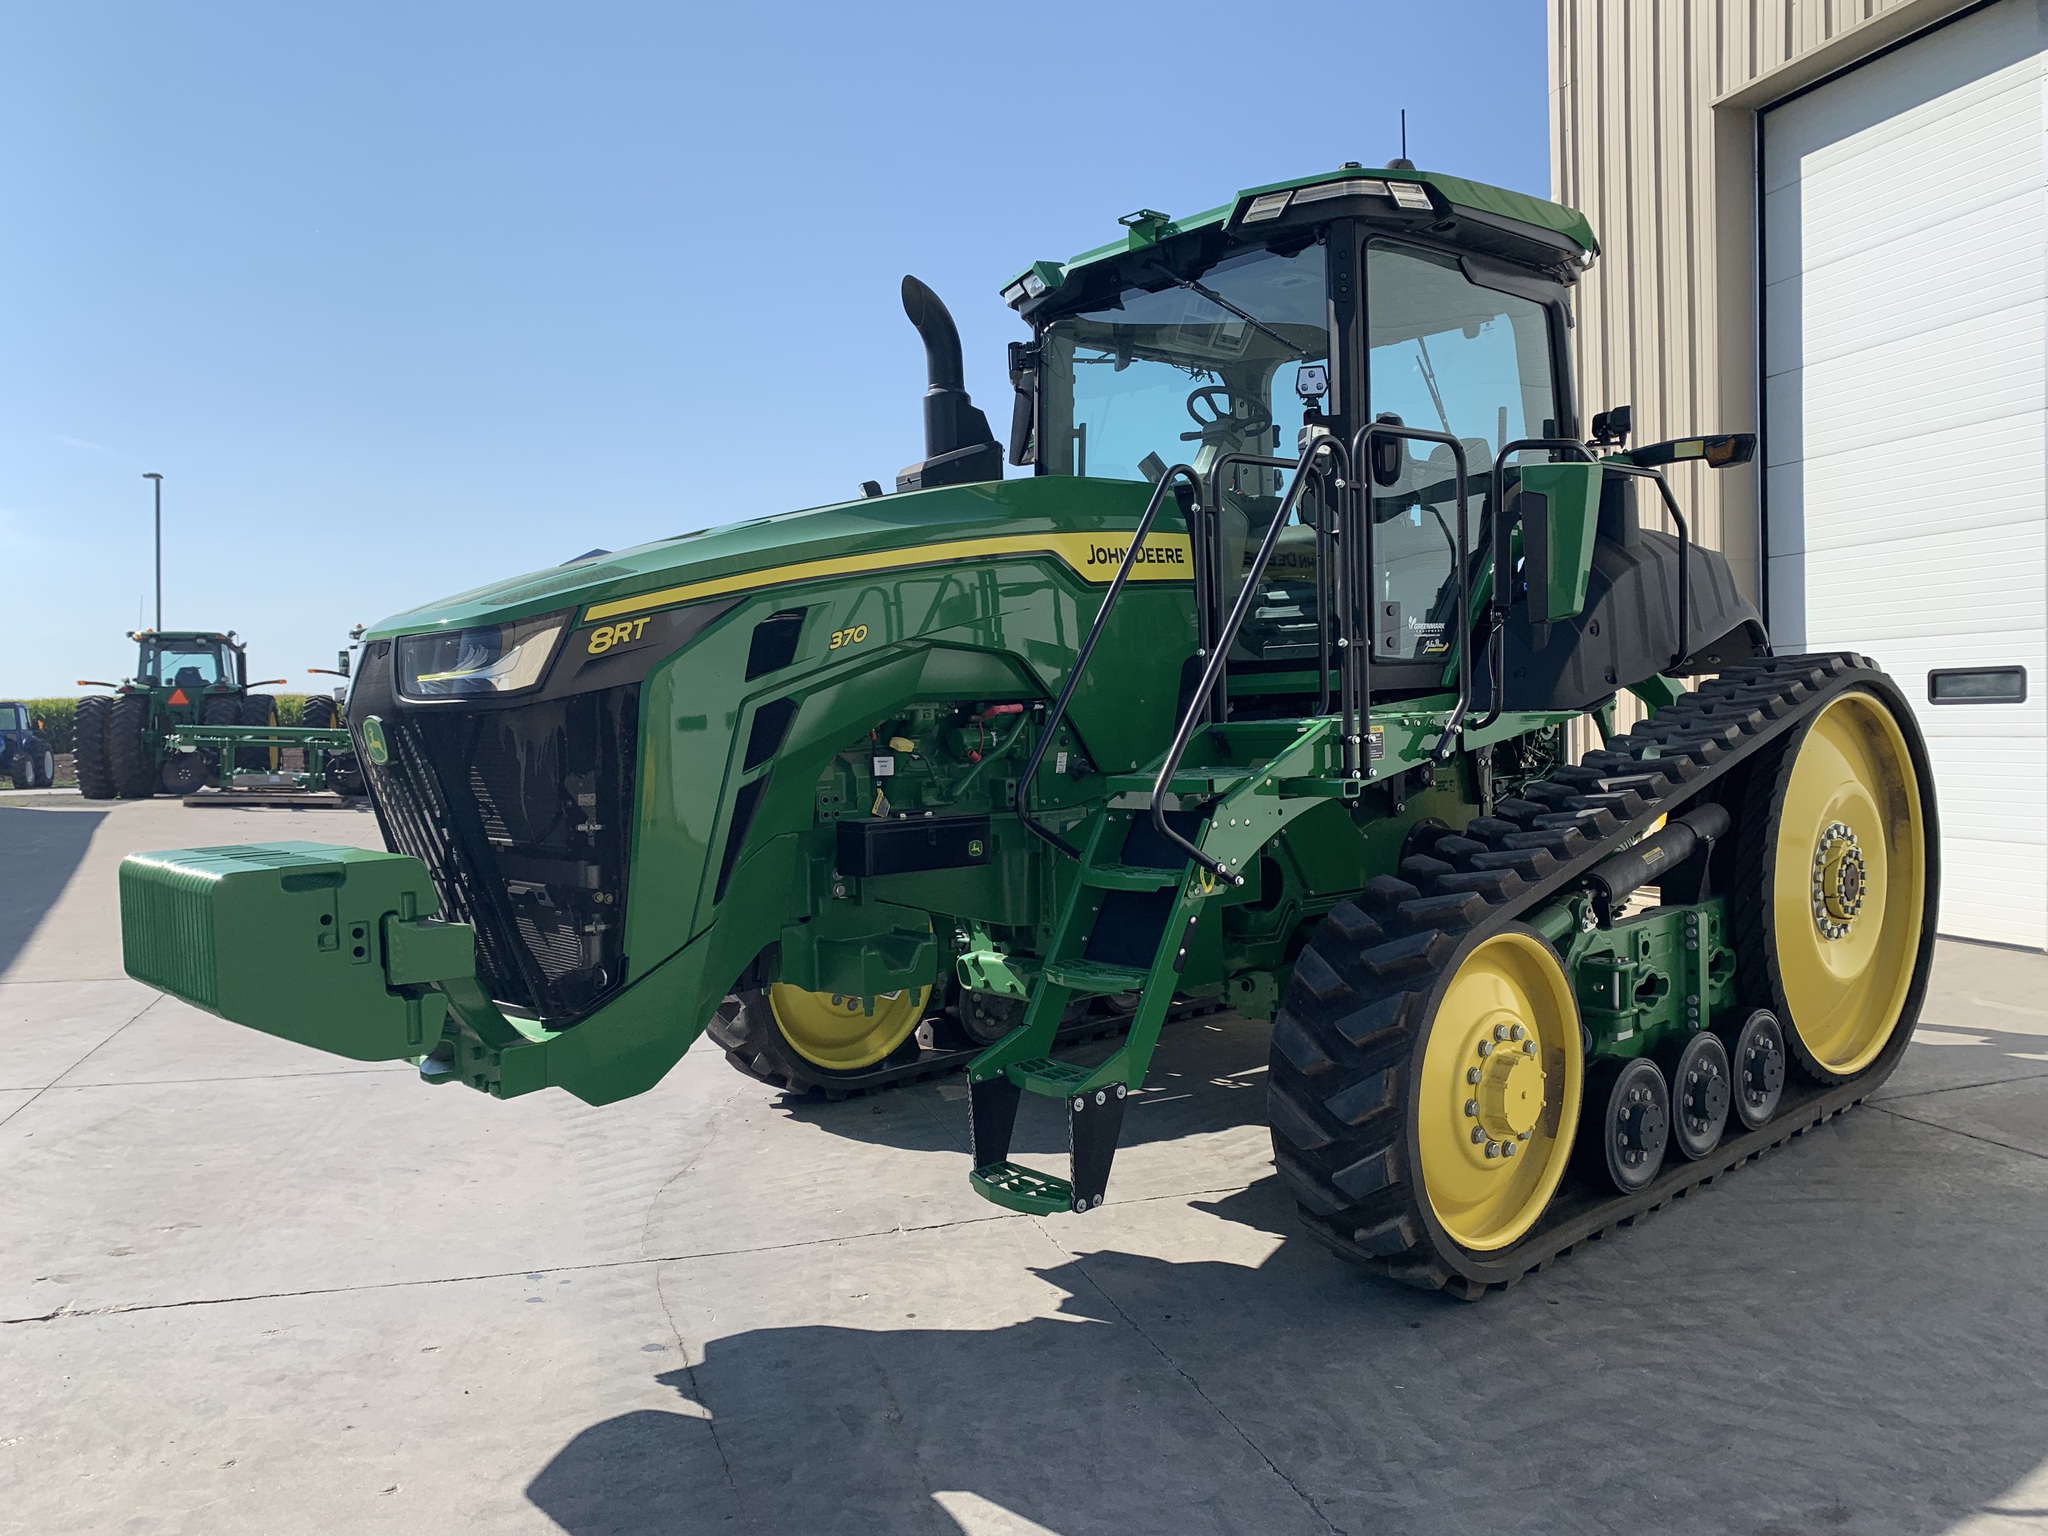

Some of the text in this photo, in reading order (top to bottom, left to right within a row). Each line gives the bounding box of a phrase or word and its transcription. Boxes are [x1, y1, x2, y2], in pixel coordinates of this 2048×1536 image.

[1135, 546, 1185, 563] DEERE
[587, 616, 651, 654] 8RT
[829, 624, 868, 650] 370
